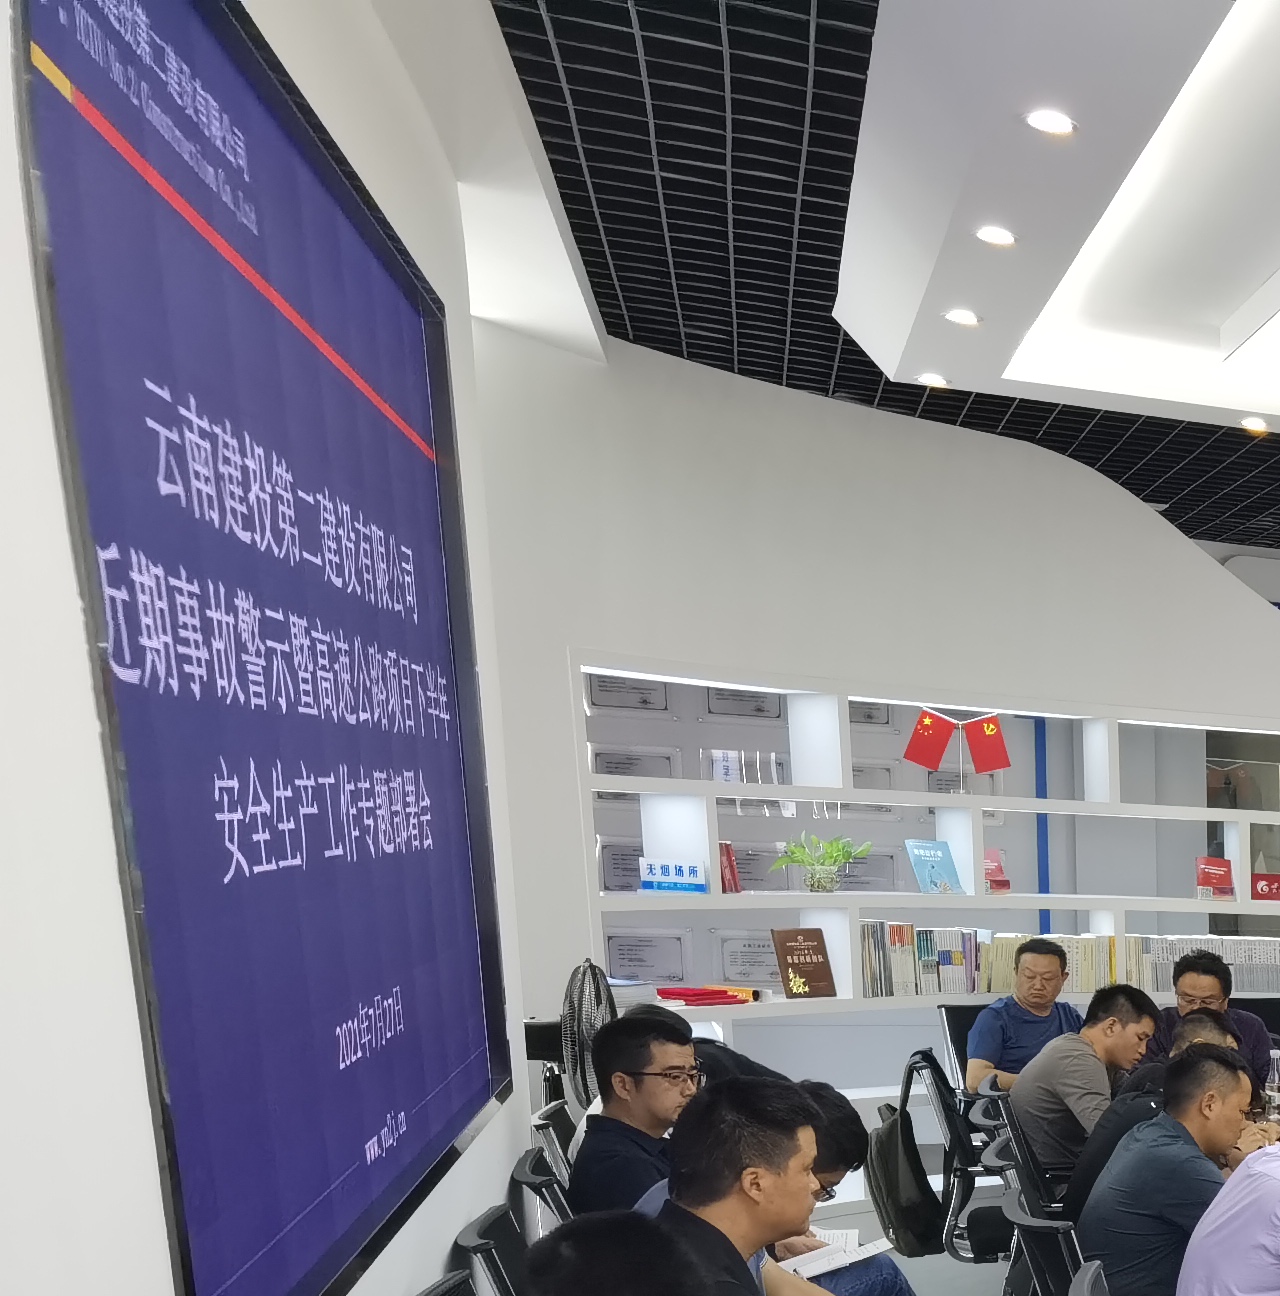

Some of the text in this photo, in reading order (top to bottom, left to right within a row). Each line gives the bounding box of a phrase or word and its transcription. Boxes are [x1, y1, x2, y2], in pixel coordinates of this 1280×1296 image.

[143, 378, 419, 625] 云南建投第二建设有限公司
[96, 542, 451, 741] 近期事故警示暨高速公路项目下半年
[213, 756, 433, 884] 安全生产工作专题部署会
[646, 863, 699, 878] 无烟场所
[335, 986, 404, 1070] 2021年7月27日
